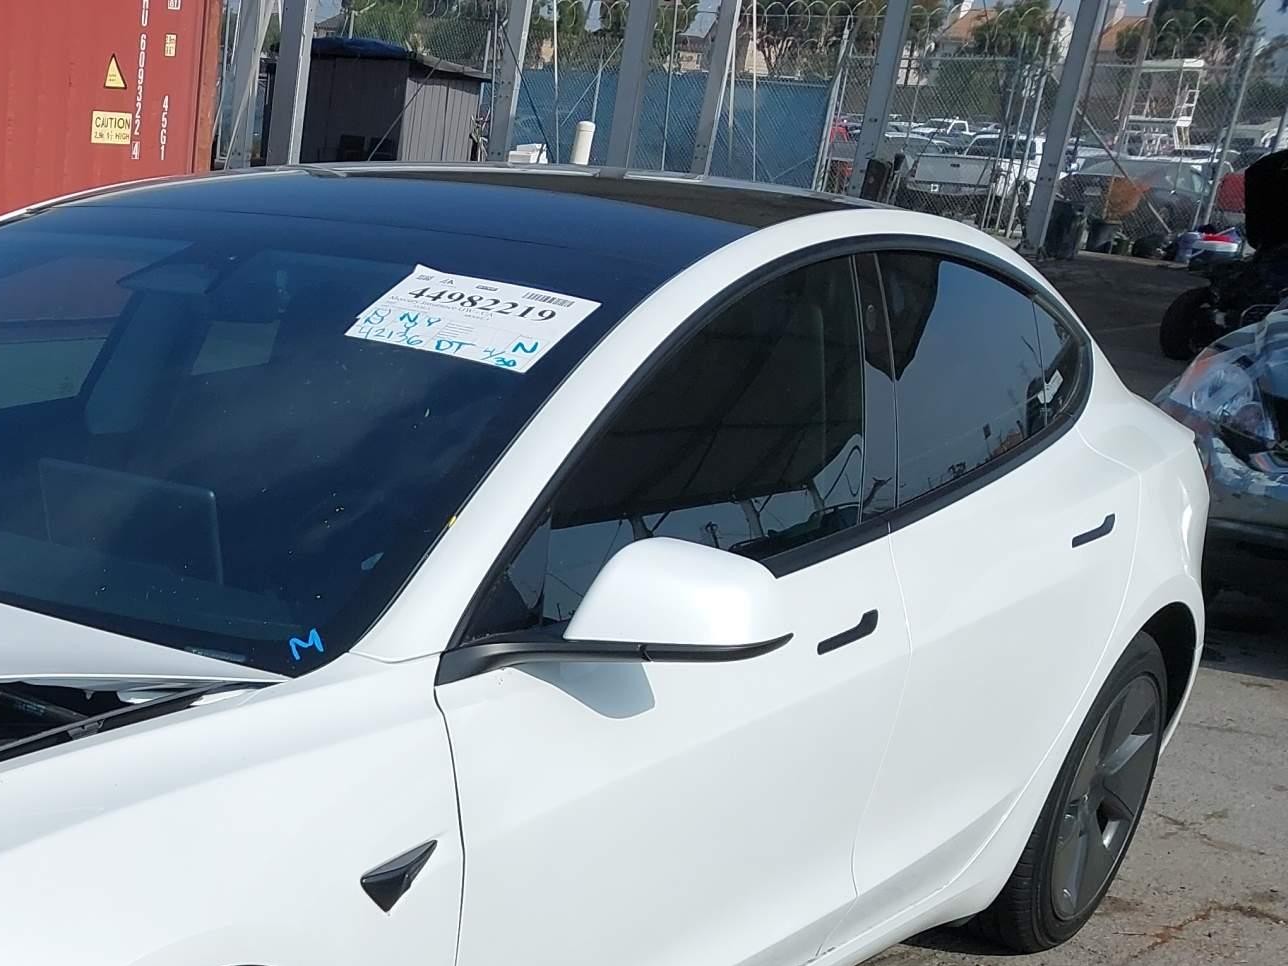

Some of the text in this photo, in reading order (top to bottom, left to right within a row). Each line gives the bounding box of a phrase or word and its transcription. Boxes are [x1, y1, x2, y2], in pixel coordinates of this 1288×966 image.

[94, 117, 131, 130] CAUTION
[160, 95, 169, 160] 45G1
[408, 286, 557, 323] 44982219
[289, 627, 324, 660] M
